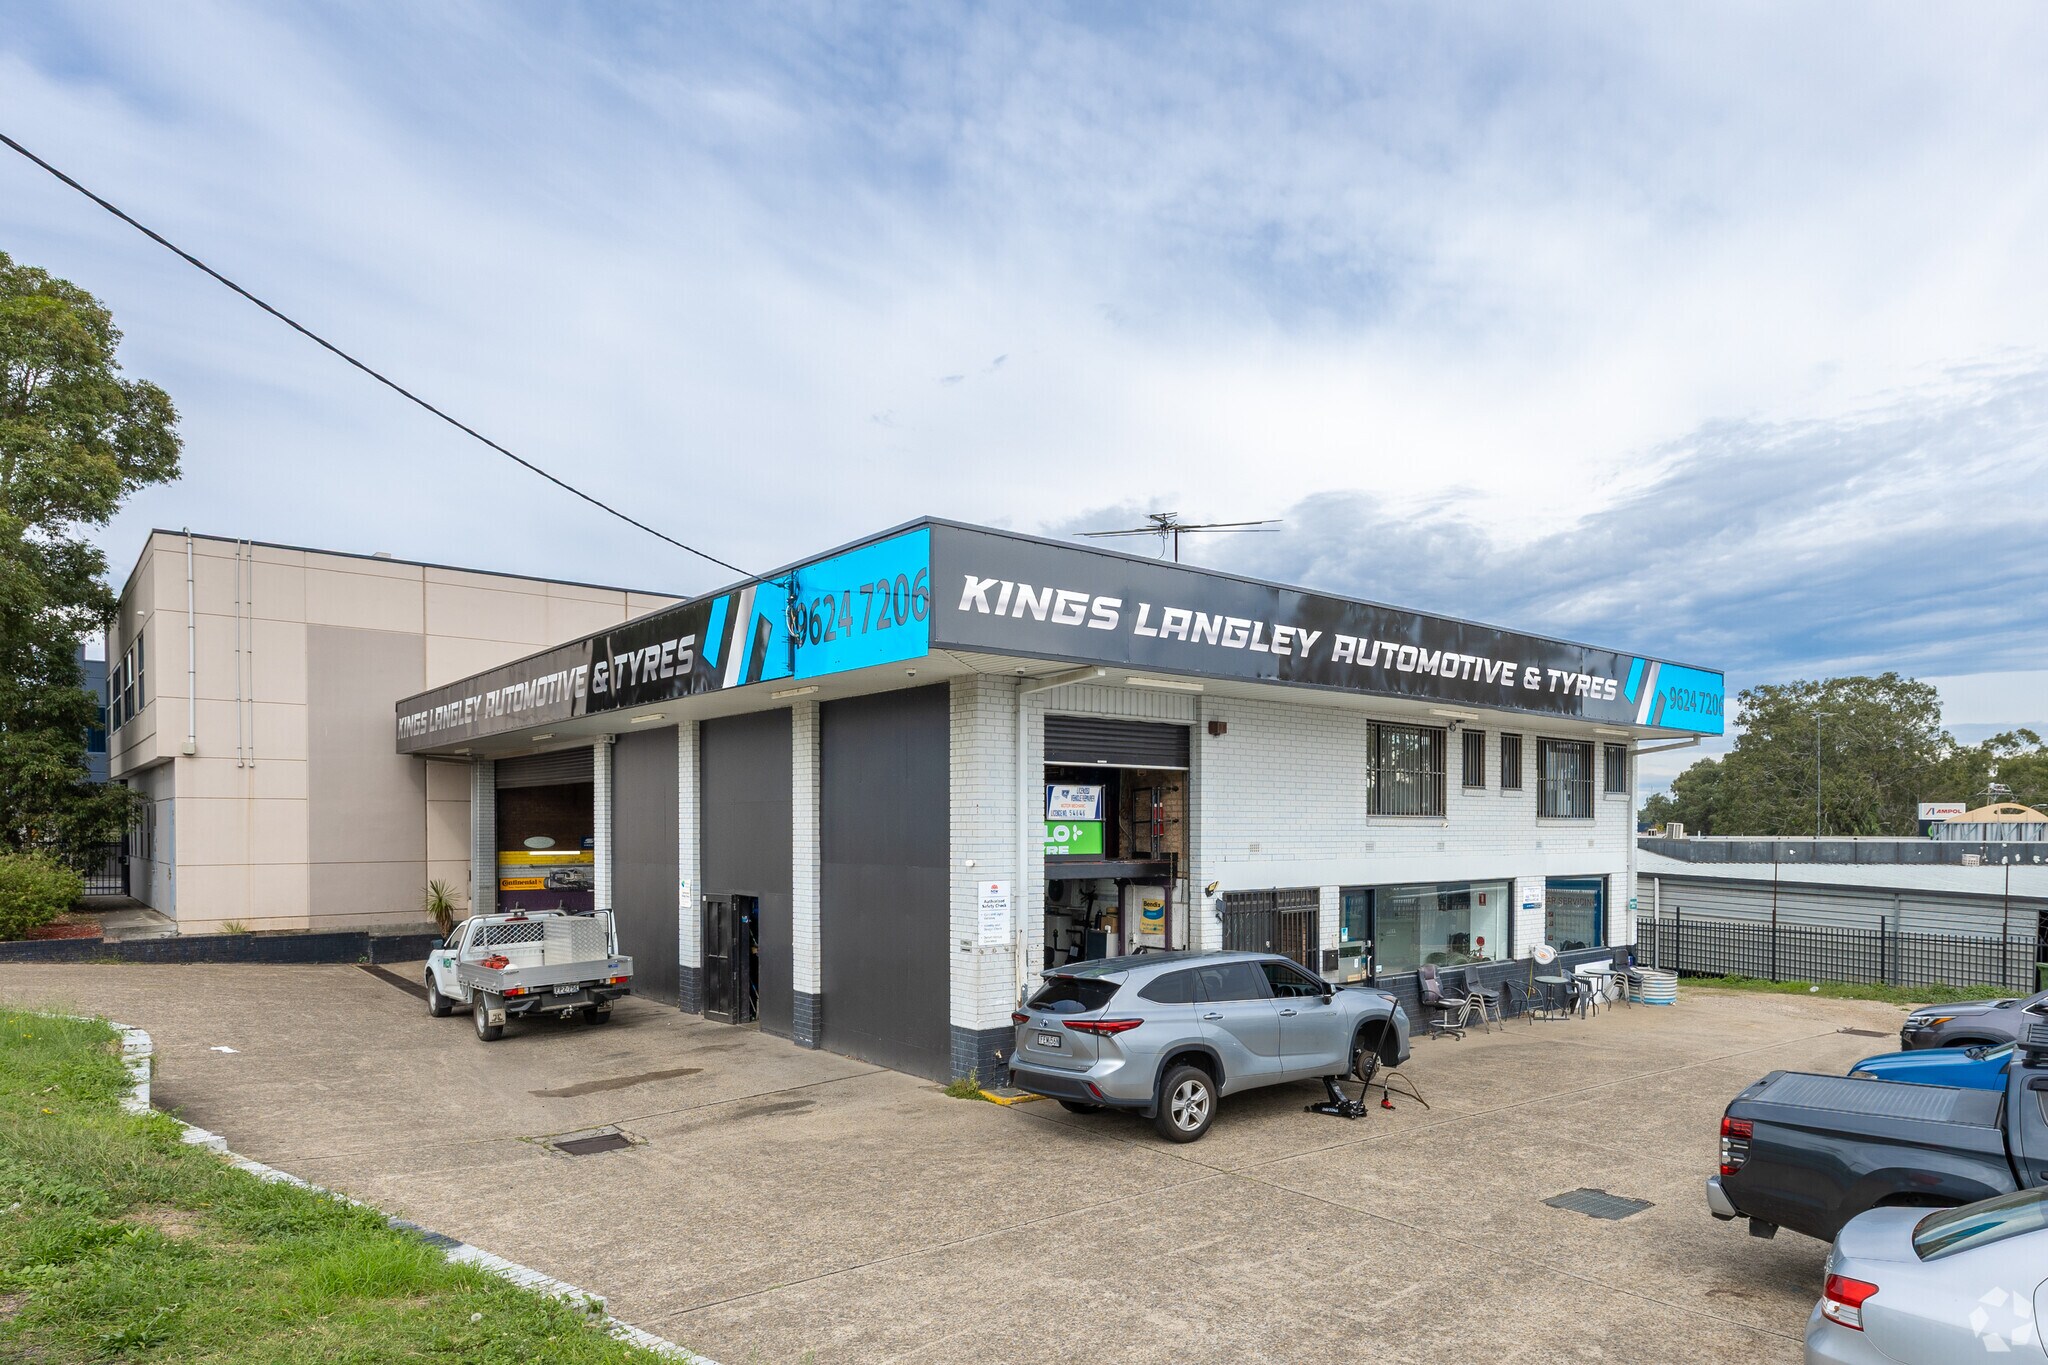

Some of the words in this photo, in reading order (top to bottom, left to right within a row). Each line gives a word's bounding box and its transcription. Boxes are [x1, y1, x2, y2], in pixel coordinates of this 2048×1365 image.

[796, 590, 853, 649] 9624
[859, 567, 929, 635] 7206
[958, 575, 1123, 631] KINGS
[1133, 602, 1322, 658] LANGLEY
[1331, 633, 1518, 687] AUTOMOTIVE
[1523, 666, 1541, 691] &
[1547, 668, 1618, 701] TYRES
[398, 711, 428, 740] KINGS
[429, 695, 482, 732] LANGLEY
[484, 664, 588, 719] AUTOMOTIVE
[592, 660, 609, 694] &
[614, 633, 695, 689] TYRES
[1670, 686, 1697, 712] 9624
[1699, 691, 1724, 717] 7206
